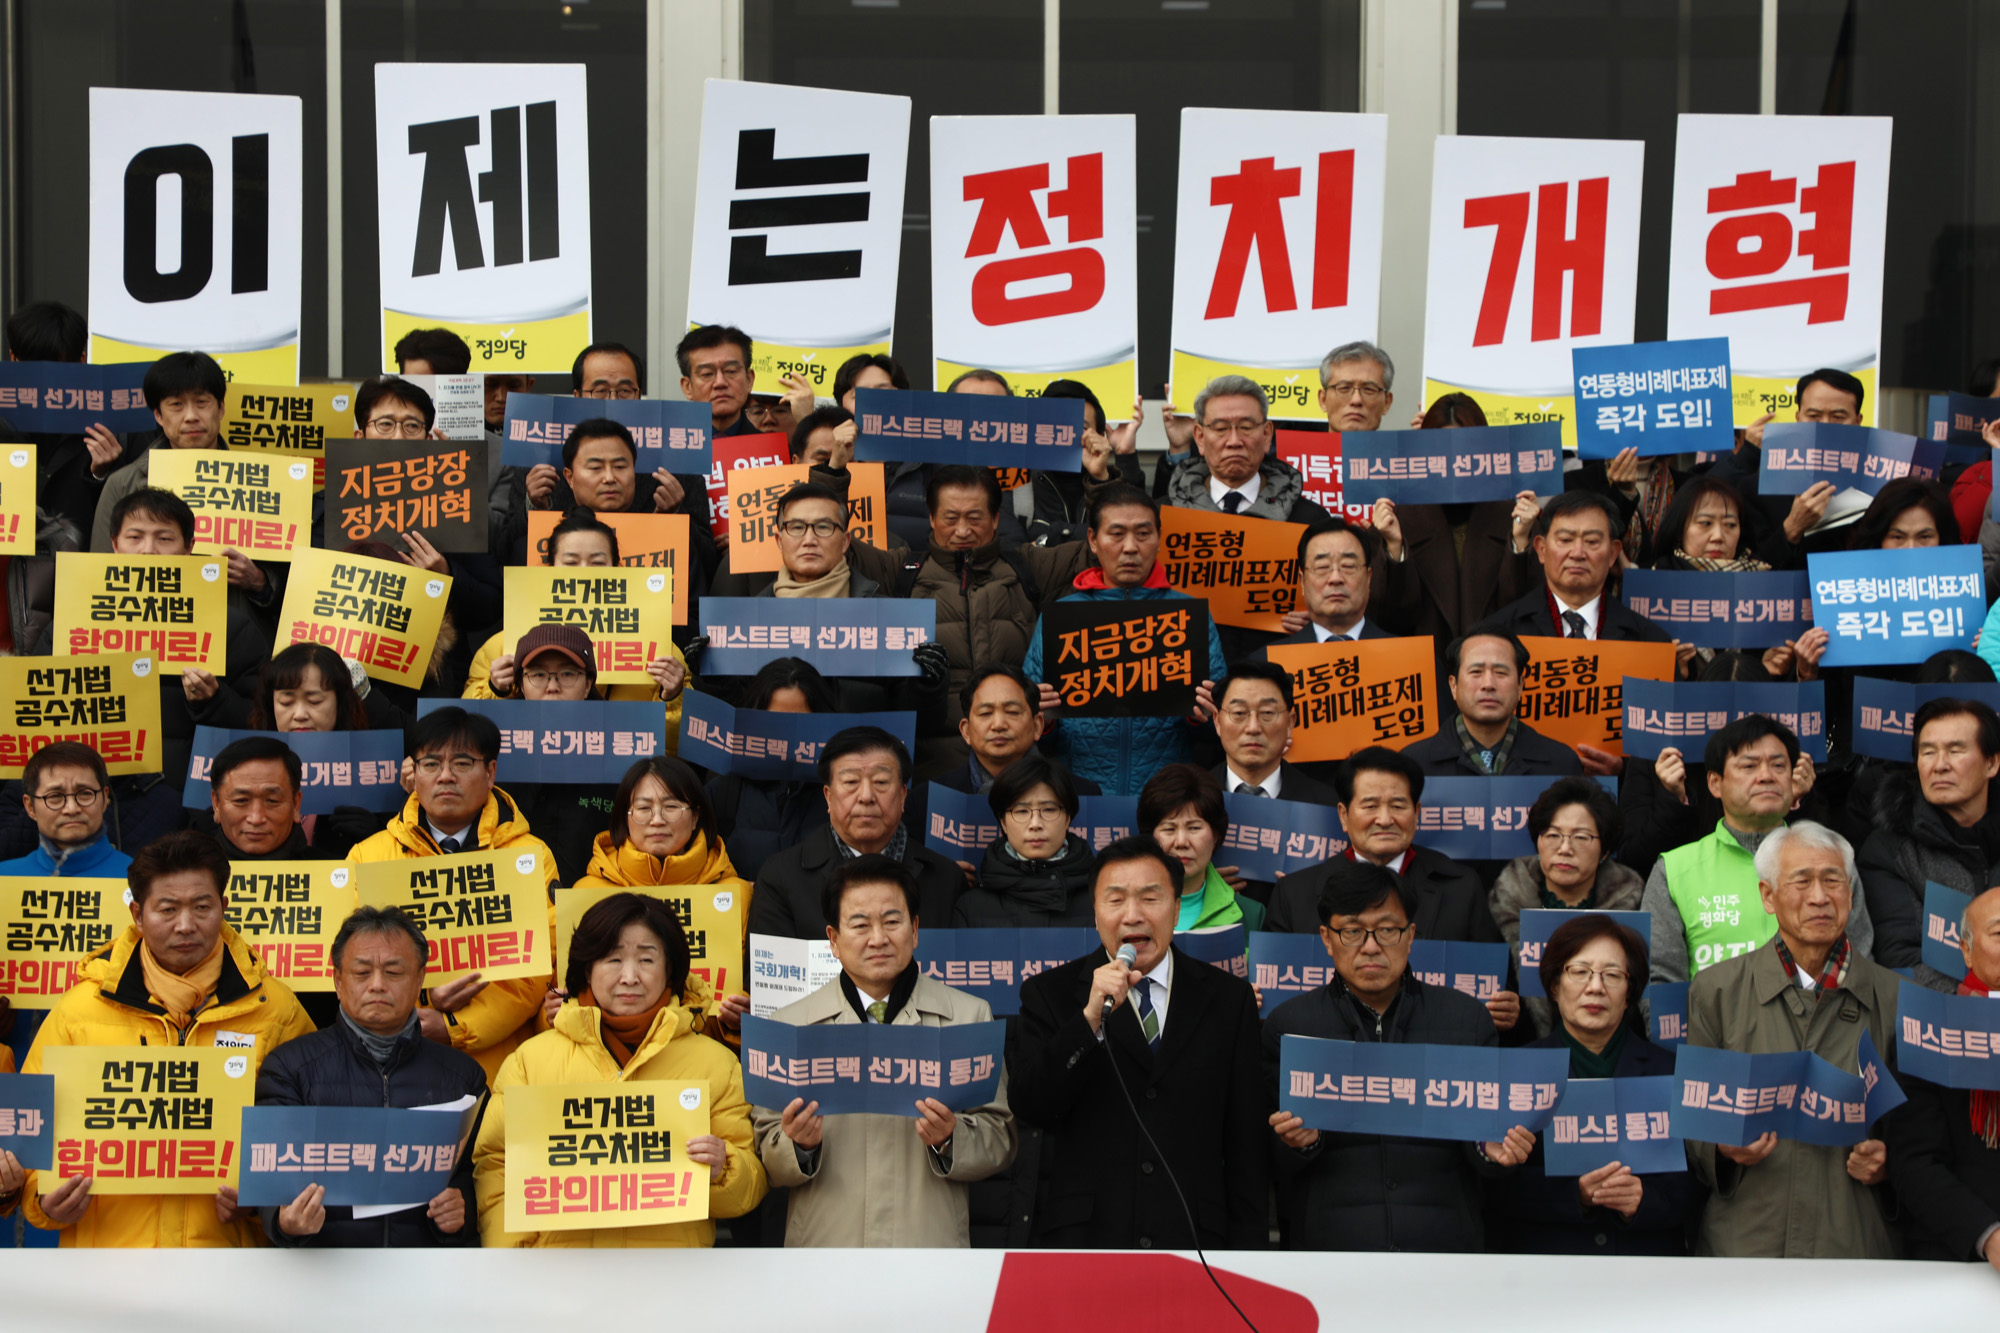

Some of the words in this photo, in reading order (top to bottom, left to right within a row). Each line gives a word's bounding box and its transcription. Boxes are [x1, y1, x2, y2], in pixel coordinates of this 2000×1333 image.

[408, 100, 560, 278] 제
[123, 132, 269, 304] 이
[728, 128, 870, 286] 는
[962, 151, 1105, 325] 정
[1204, 149, 1355, 320] 치
[1705, 160, 1856, 325] 혁
[1464, 176, 1609, 347] 개
[476, 338, 527, 360] 정의당
[776, 361, 827, 385] 정의당
[1579, 365, 1727, 399] 연동형비례대표제
[44, 388, 104, 411] 선거법
[240, 394, 314, 423] 선거법
[1261, 383, 1310, 405] 정의당
[1760, 393, 1799, 414] 정의
[862, 414, 963, 440] 패스트트랙
[968, 420, 1028, 445] 선거법
[1034, 424, 1076, 446] 통과
[1596, 404, 1646, 433] 즉각
[1655, 398, 1713, 429] 도입!
[228, 424, 325, 450] 공수처법
[509, 418, 578, 446] 패스트트
[632, 427, 662, 449] 거법
[669, 427, 706, 450] 통과
[195, 460, 270, 488] 선거법
[339, 449, 470, 499] 지금당장
[1349, 456, 1447, 480] 패스트트랙
[1453, 453, 1511, 477] 선거법
[1517, 449, 1555, 474] 통과
[1767, 448, 1859, 473] 패스트트랙
[1864, 455, 1910, 480] 선거법
[181, 486, 281, 516] 공수처법
[340, 489, 471, 541] 정치개혁
[194, 516, 297, 551] 의대로!
[1165, 530, 1245, 559] 연동형
[104, 565, 182, 593] 선거법
[330, 563, 408, 601] 선거법
[1164, 558, 1299, 590] 비례대표제
[1816, 573, 1981, 605] 연동형비례대표제
[551, 579, 627, 604] 선거법
[1244, 588, 1297, 615] 도입
[91, 594, 194, 624] 공수처법
[313, 590, 412, 633] 공수처법
[539, 608, 639, 634] 공수처법
[1630, 597, 1729, 622] 패스트트랙
[1734, 597, 1795, 622] 선거법
[1836, 611, 1890, 639] 즉각
[1901, 608, 1964, 638] 도입!
[69, 628, 212, 663] 합의대로!
[290, 620, 420, 675] 합의대로!
[706, 625, 811, 649] 패스트트랙
[817, 626, 878, 650] 선거법
[884, 626, 928, 651] 통과
[1058, 609, 1191, 664] 지금당장
[592, 641, 657, 672] 대로!
[26, 664, 111, 696] 선거법
[1060, 650, 1192, 707] 정치개혁
[15, 695, 127, 727] 공수처법
[1515, 685, 1623, 723] 비례대표
[1372, 706, 1425, 742] 도입
[1627, 705, 1727, 735] 패스트트랙
[1801, 712, 1823, 736] 통과
[540, 730, 605, 755] 선거법
[612, 731, 657, 756] 통과
[687, 716, 788, 761] 패스트트랙
[358, 759, 398, 786] 통과
[930, 812, 999, 849] 패스트트
[1416, 806, 1485, 831] 트트랙
[1223, 823, 1281, 854] 트트랙
[229, 873, 310, 902] 선거법
[410, 863, 495, 899] 선거법
[20, 889, 101, 920] 선거법
[1699, 909, 1740, 928] 평화당
[1713, 894, 1740, 911] 민주
[223, 905, 322, 936] 공수처법
[7, 924, 112, 952] 공수처법
[426, 929, 534, 974] 의대로!
[253, 943, 335, 978] 대로!
[754, 961, 806, 981] 국회개혁!
[917, 960, 1014, 986] 스트트랙
[0, 959, 79, 996] 합의대
[101, 1060, 198, 1095] 선거법
[748, 1048, 861, 1087] 패스트트랙
[868, 1057, 941, 1088] 선거법
[948, 1054, 995, 1087] 통과
[1289, 1070, 1416, 1106] 패스트트랙
[1423, 1078, 1500, 1111] 선거법
[1508, 1082, 1558, 1112] 통과
[1682, 1079, 1797, 1116] 패스트트랙
[1800, 1084, 1866, 1123] 선거법
[84, 1097, 213, 1132] 공수처법
[562, 1095, 655, 1130] 선거법
[1625, 1111, 1670, 1141] 통과
[57, 1139, 235, 1181] 합의대로!
[250, 1142, 376, 1173] 패스트트랙
[383, 1143, 457, 1173] 선거법
[547, 1131, 671, 1167] 공수처법
[523, 1172, 693, 1216] 합의대로!
